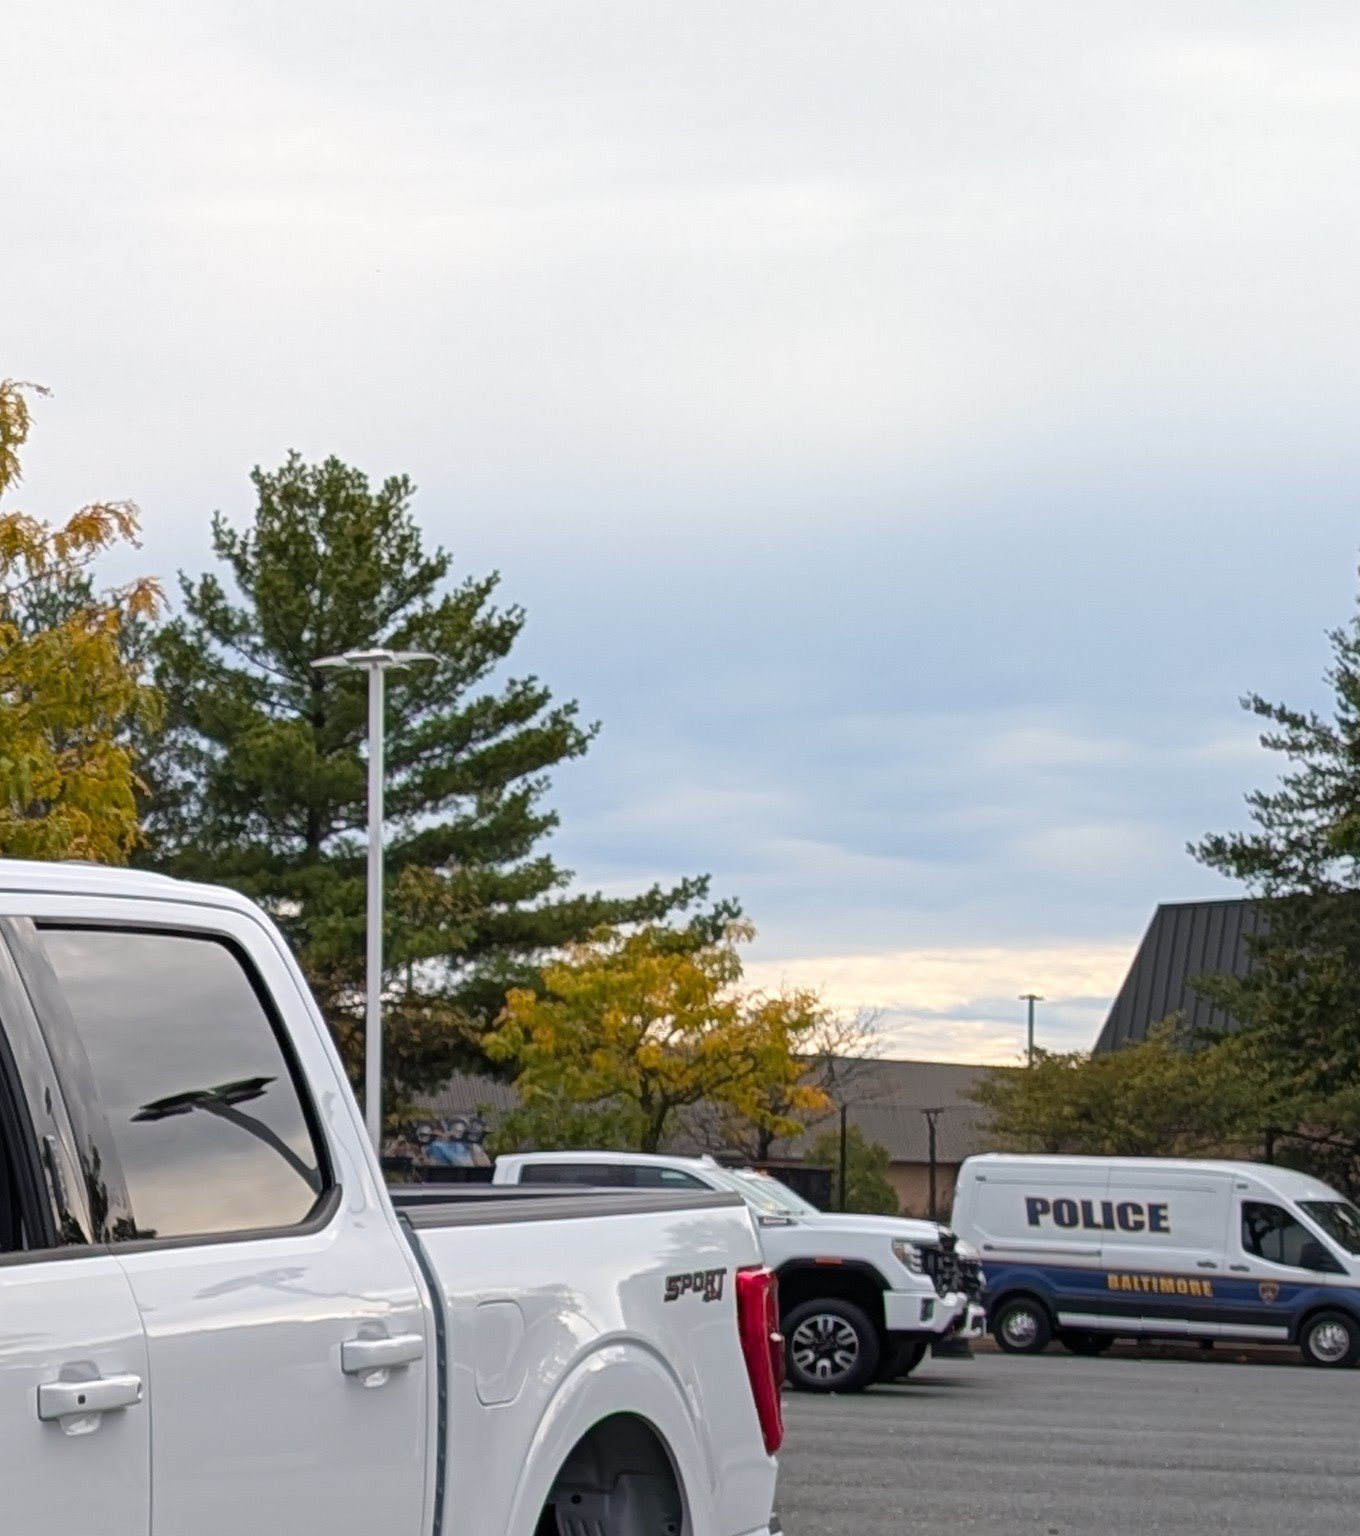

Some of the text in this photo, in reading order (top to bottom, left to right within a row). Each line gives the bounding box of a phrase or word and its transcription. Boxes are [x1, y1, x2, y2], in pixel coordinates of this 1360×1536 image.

[1025, 1197, 1171, 1233] POLICE
[664, 1267, 727, 1302] SPORT
[1107, 1273, 1214, 1298] BALTIMORE
